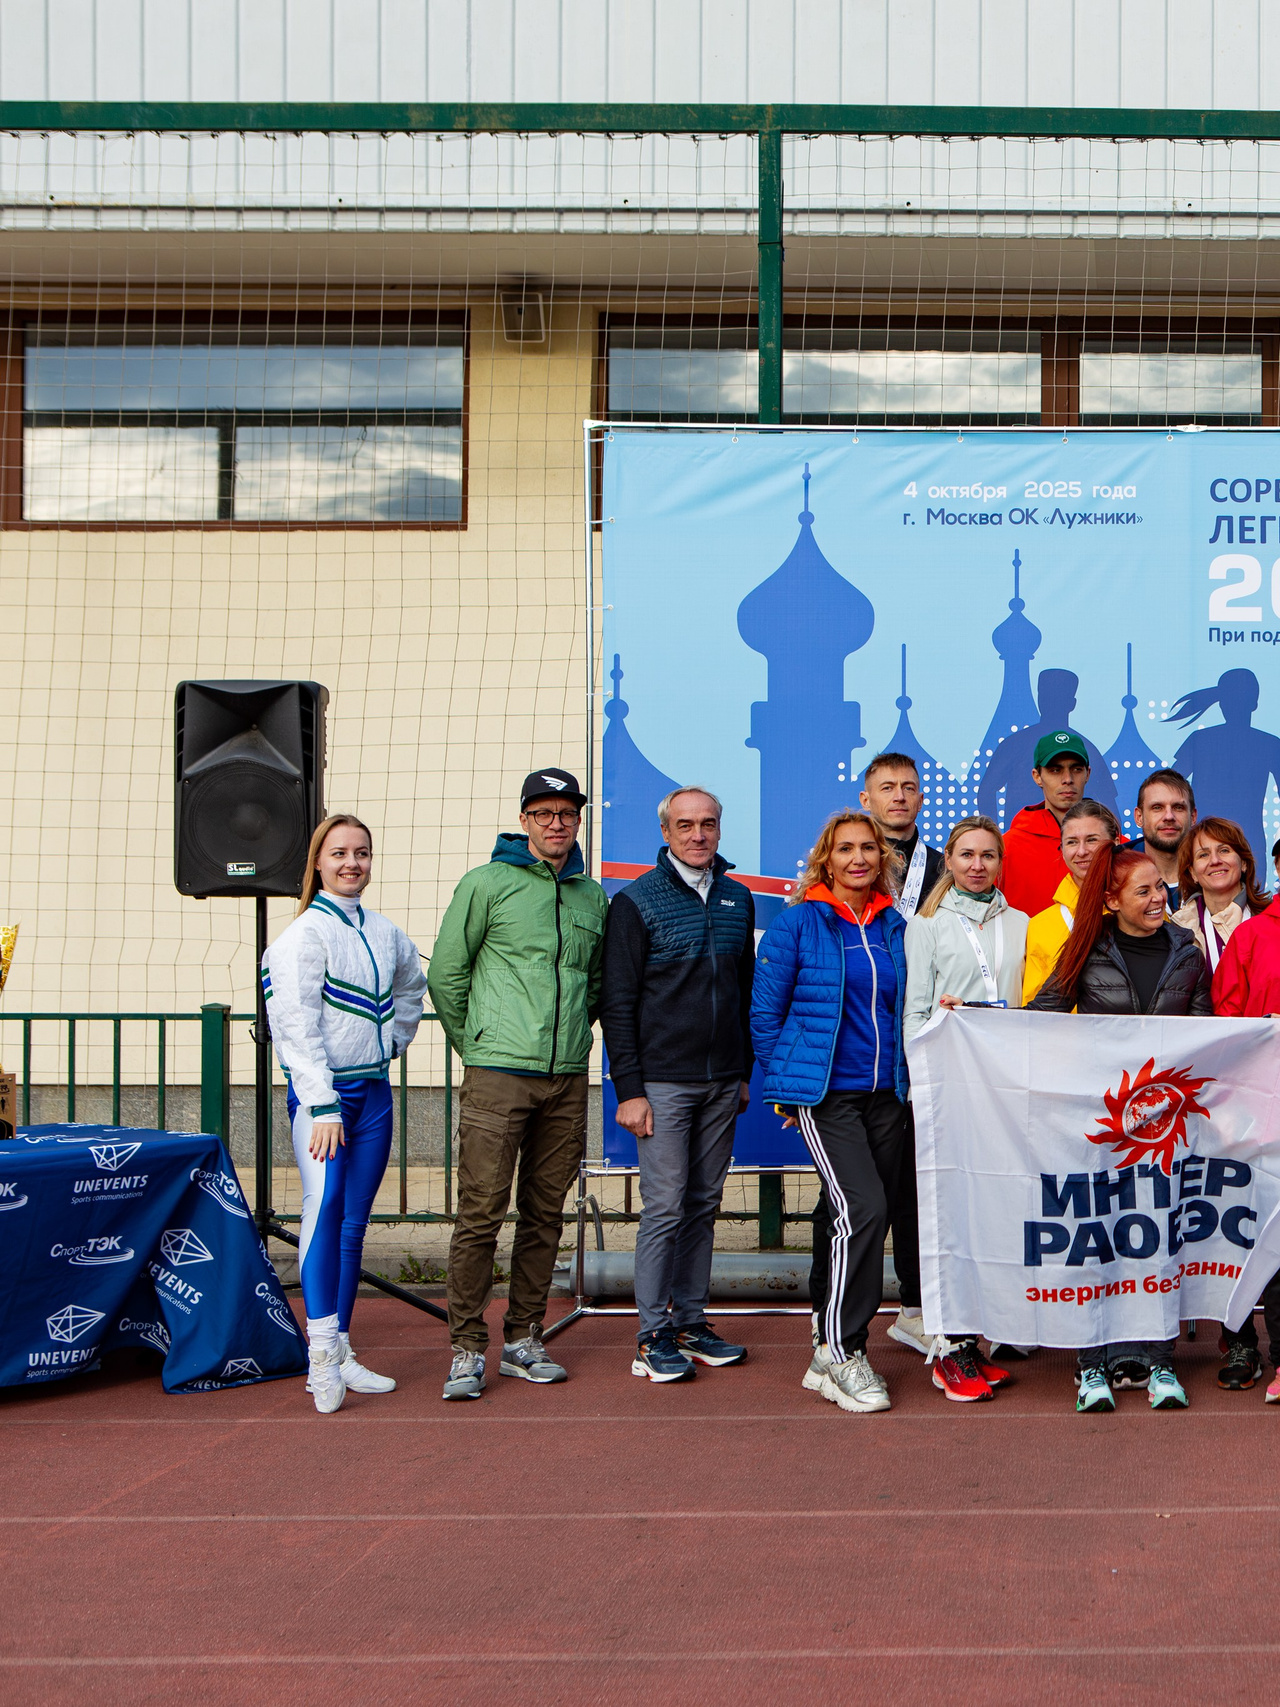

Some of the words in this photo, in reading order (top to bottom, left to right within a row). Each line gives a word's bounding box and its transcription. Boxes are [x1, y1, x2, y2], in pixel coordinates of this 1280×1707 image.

[903, 481, 918, 498] 4
[927, 482, 1007, 503] октября
[1024, 481, 1082, 499] 2025
[1092, 484, 1137, 500] года
[903, 512, 916, 526] г.
[926, 508, 1003, 526] Москва
[1008, 508, 1039, 526] ОК
[1043, 508, 1144, 529] «Лужники»
[1209, 627, 1245, 645] При
[73, 1174, 149, 1194] UNEVENTS
[1041, 1154, 1252, 1218] ИНТЕР
[1024, 1213, 1160, 1267] РАО
[147, 1260, 203, 1305] EVENTS
[1026, 1279, 1136, 1305] энергия
[1143, 1274, 1181, 1294] без
[28, 1344, 100, 1367] UNEVENT
